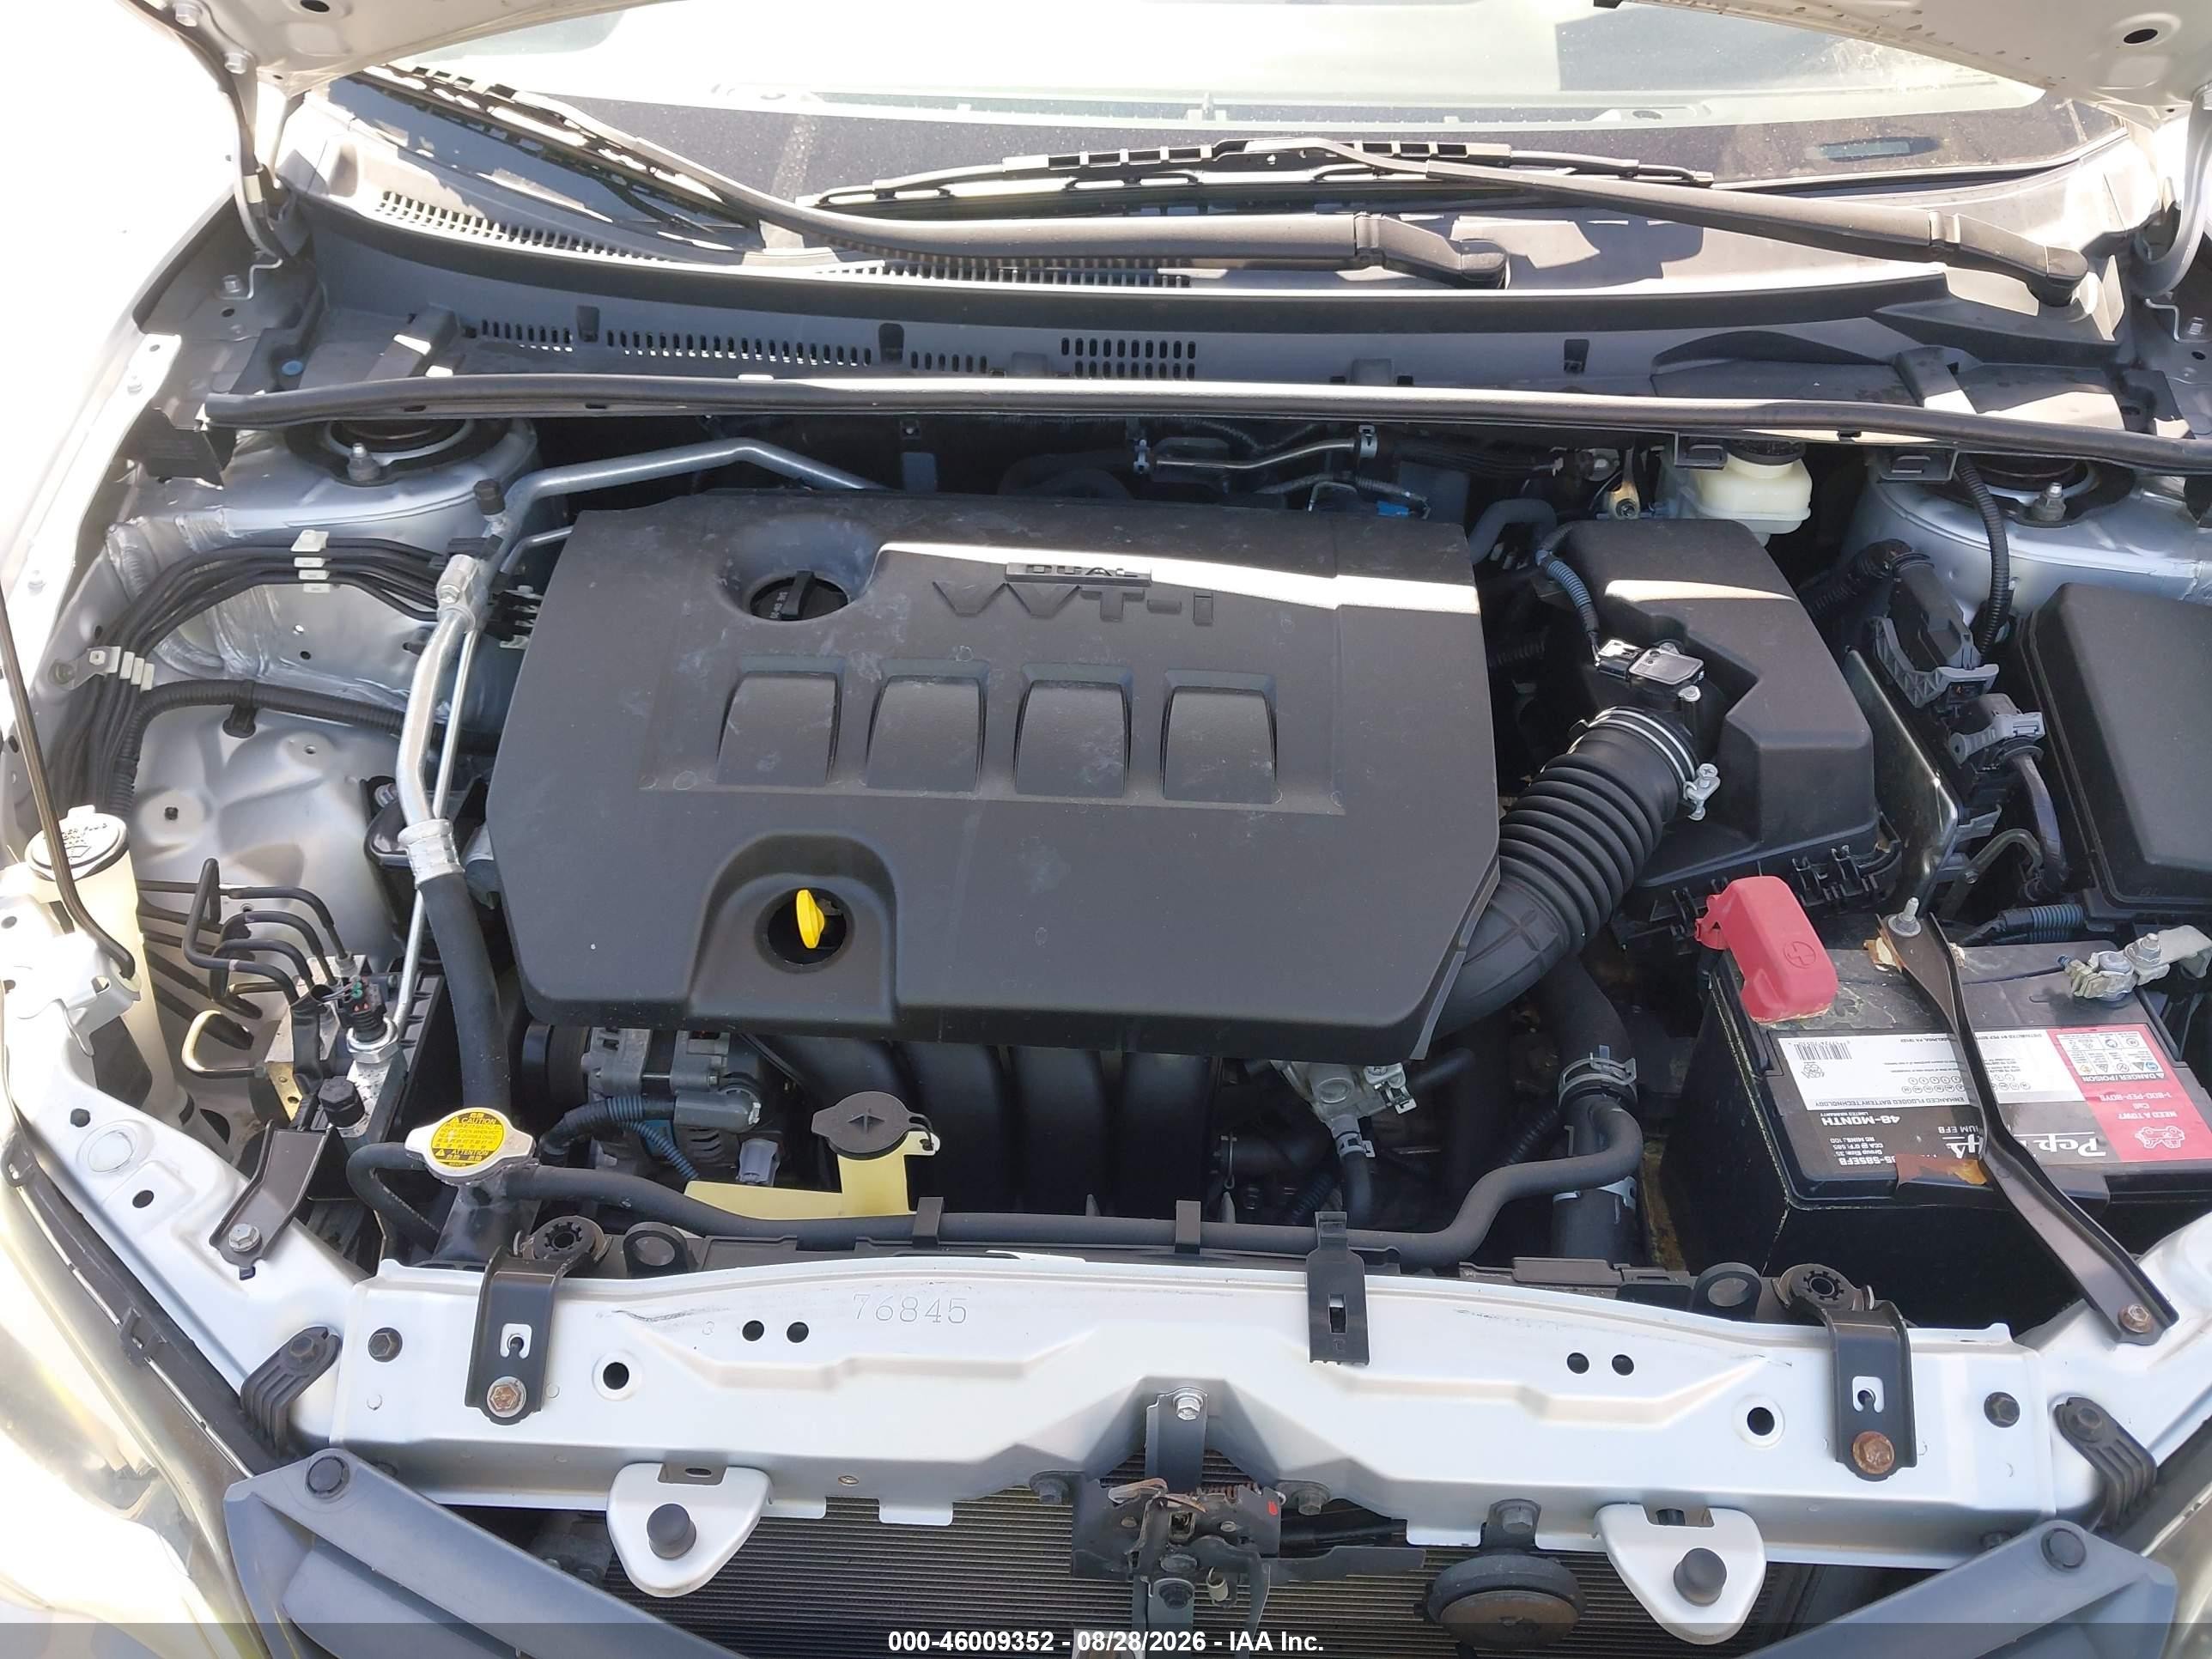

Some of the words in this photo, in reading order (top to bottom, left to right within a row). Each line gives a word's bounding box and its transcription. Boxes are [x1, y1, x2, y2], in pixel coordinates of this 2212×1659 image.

[2120, 1073, 2156, 1081] DANGER
[1821, 1115, 1901, 1127] 48-MONTH
[2033, 1133, 2106, 1158] Pep
[853, 1293, 969, 1324] 76845
